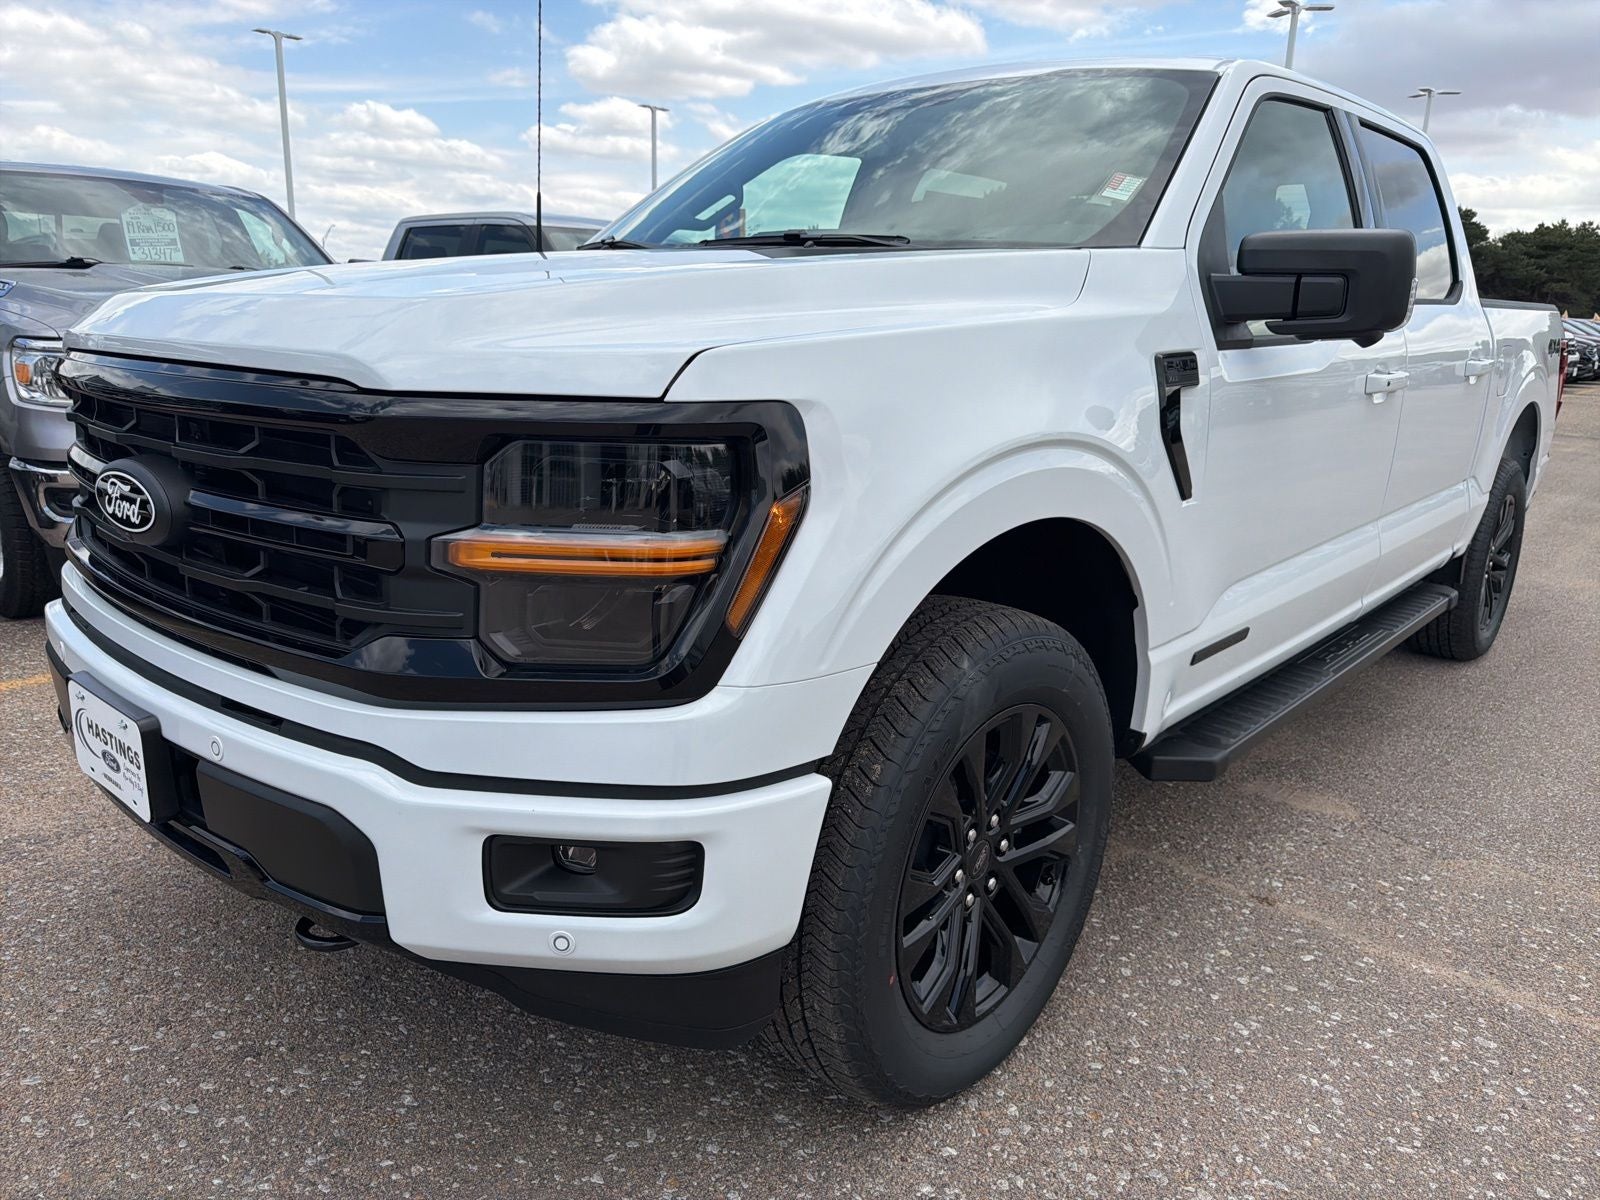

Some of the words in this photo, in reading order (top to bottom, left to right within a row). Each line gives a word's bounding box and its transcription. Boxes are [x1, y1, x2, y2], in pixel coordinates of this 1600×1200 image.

[154, 221, 176, 234] 1500
[105, 478, 141, 525] Ford
[86, 717, 141, 771] HASTINGS
